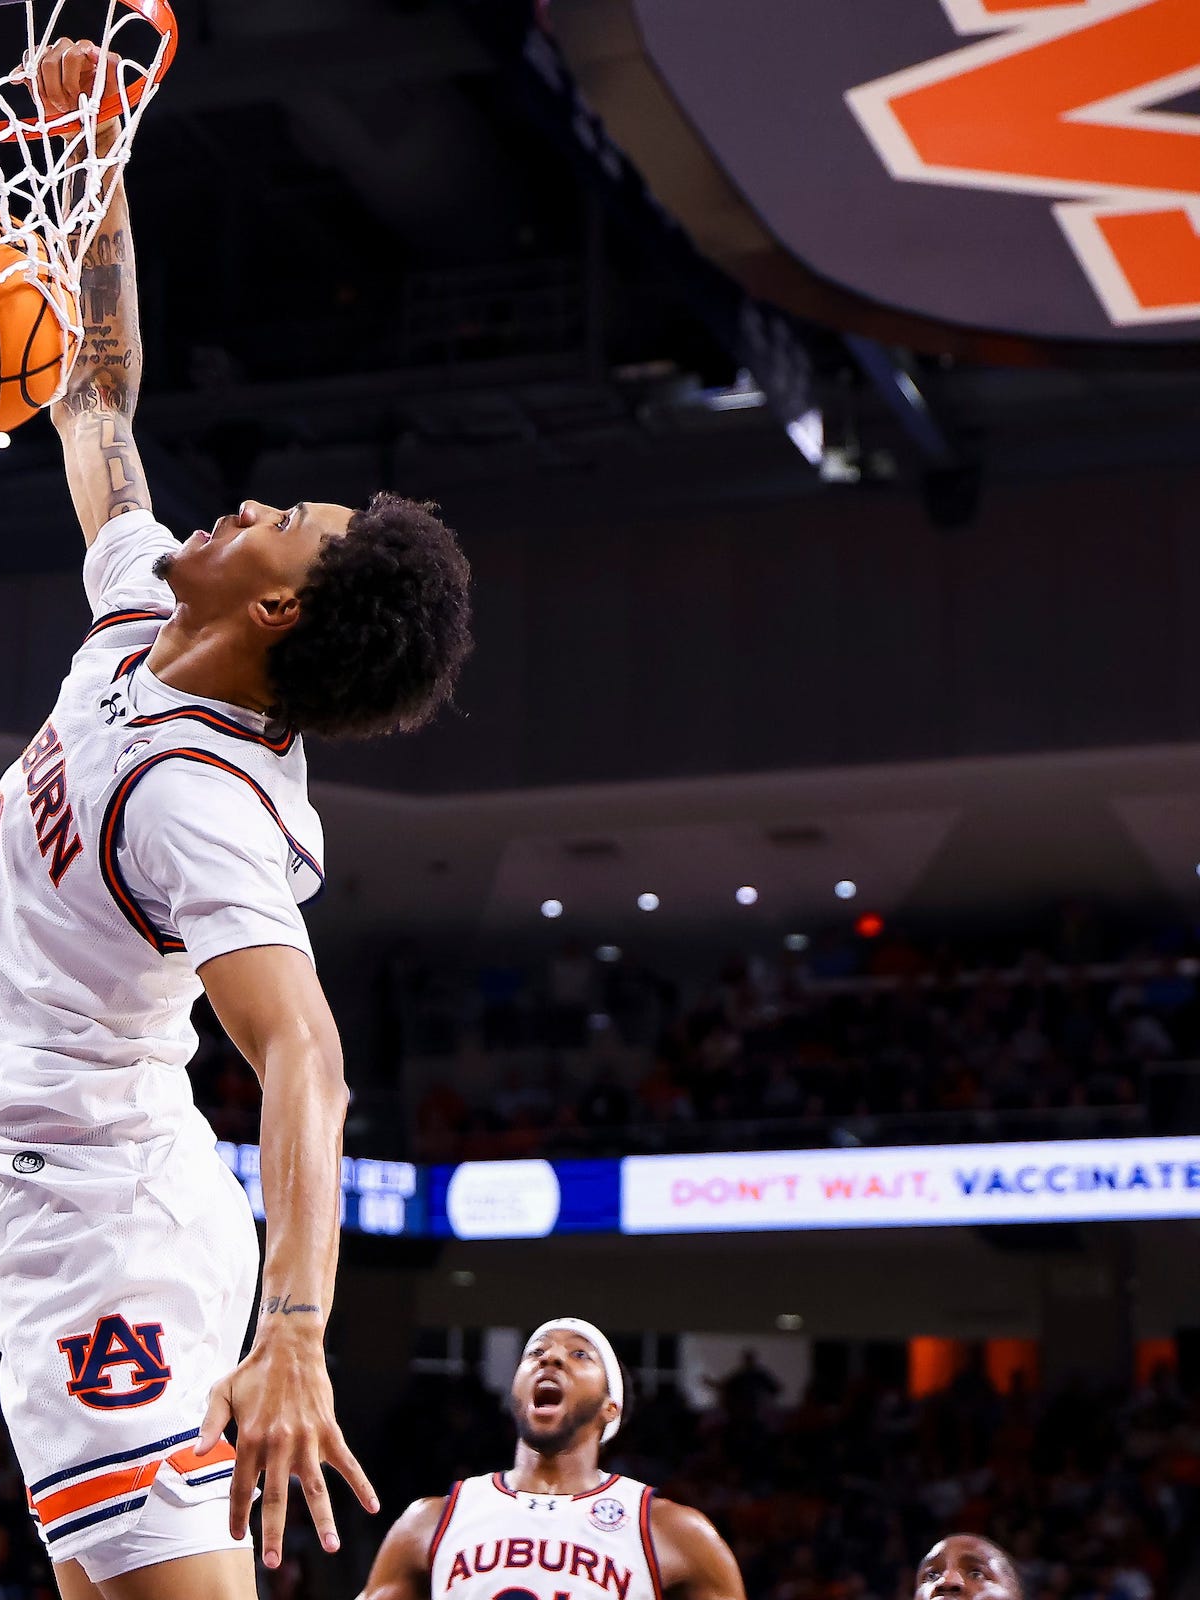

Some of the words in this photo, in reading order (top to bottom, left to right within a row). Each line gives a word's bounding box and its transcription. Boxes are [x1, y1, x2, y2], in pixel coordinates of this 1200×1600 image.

[671, 1175, 799, 1206] DON'T
[820, 1169, 940, 1202] WAIT,
[446, 1537, 633, 1600] AUBURN
